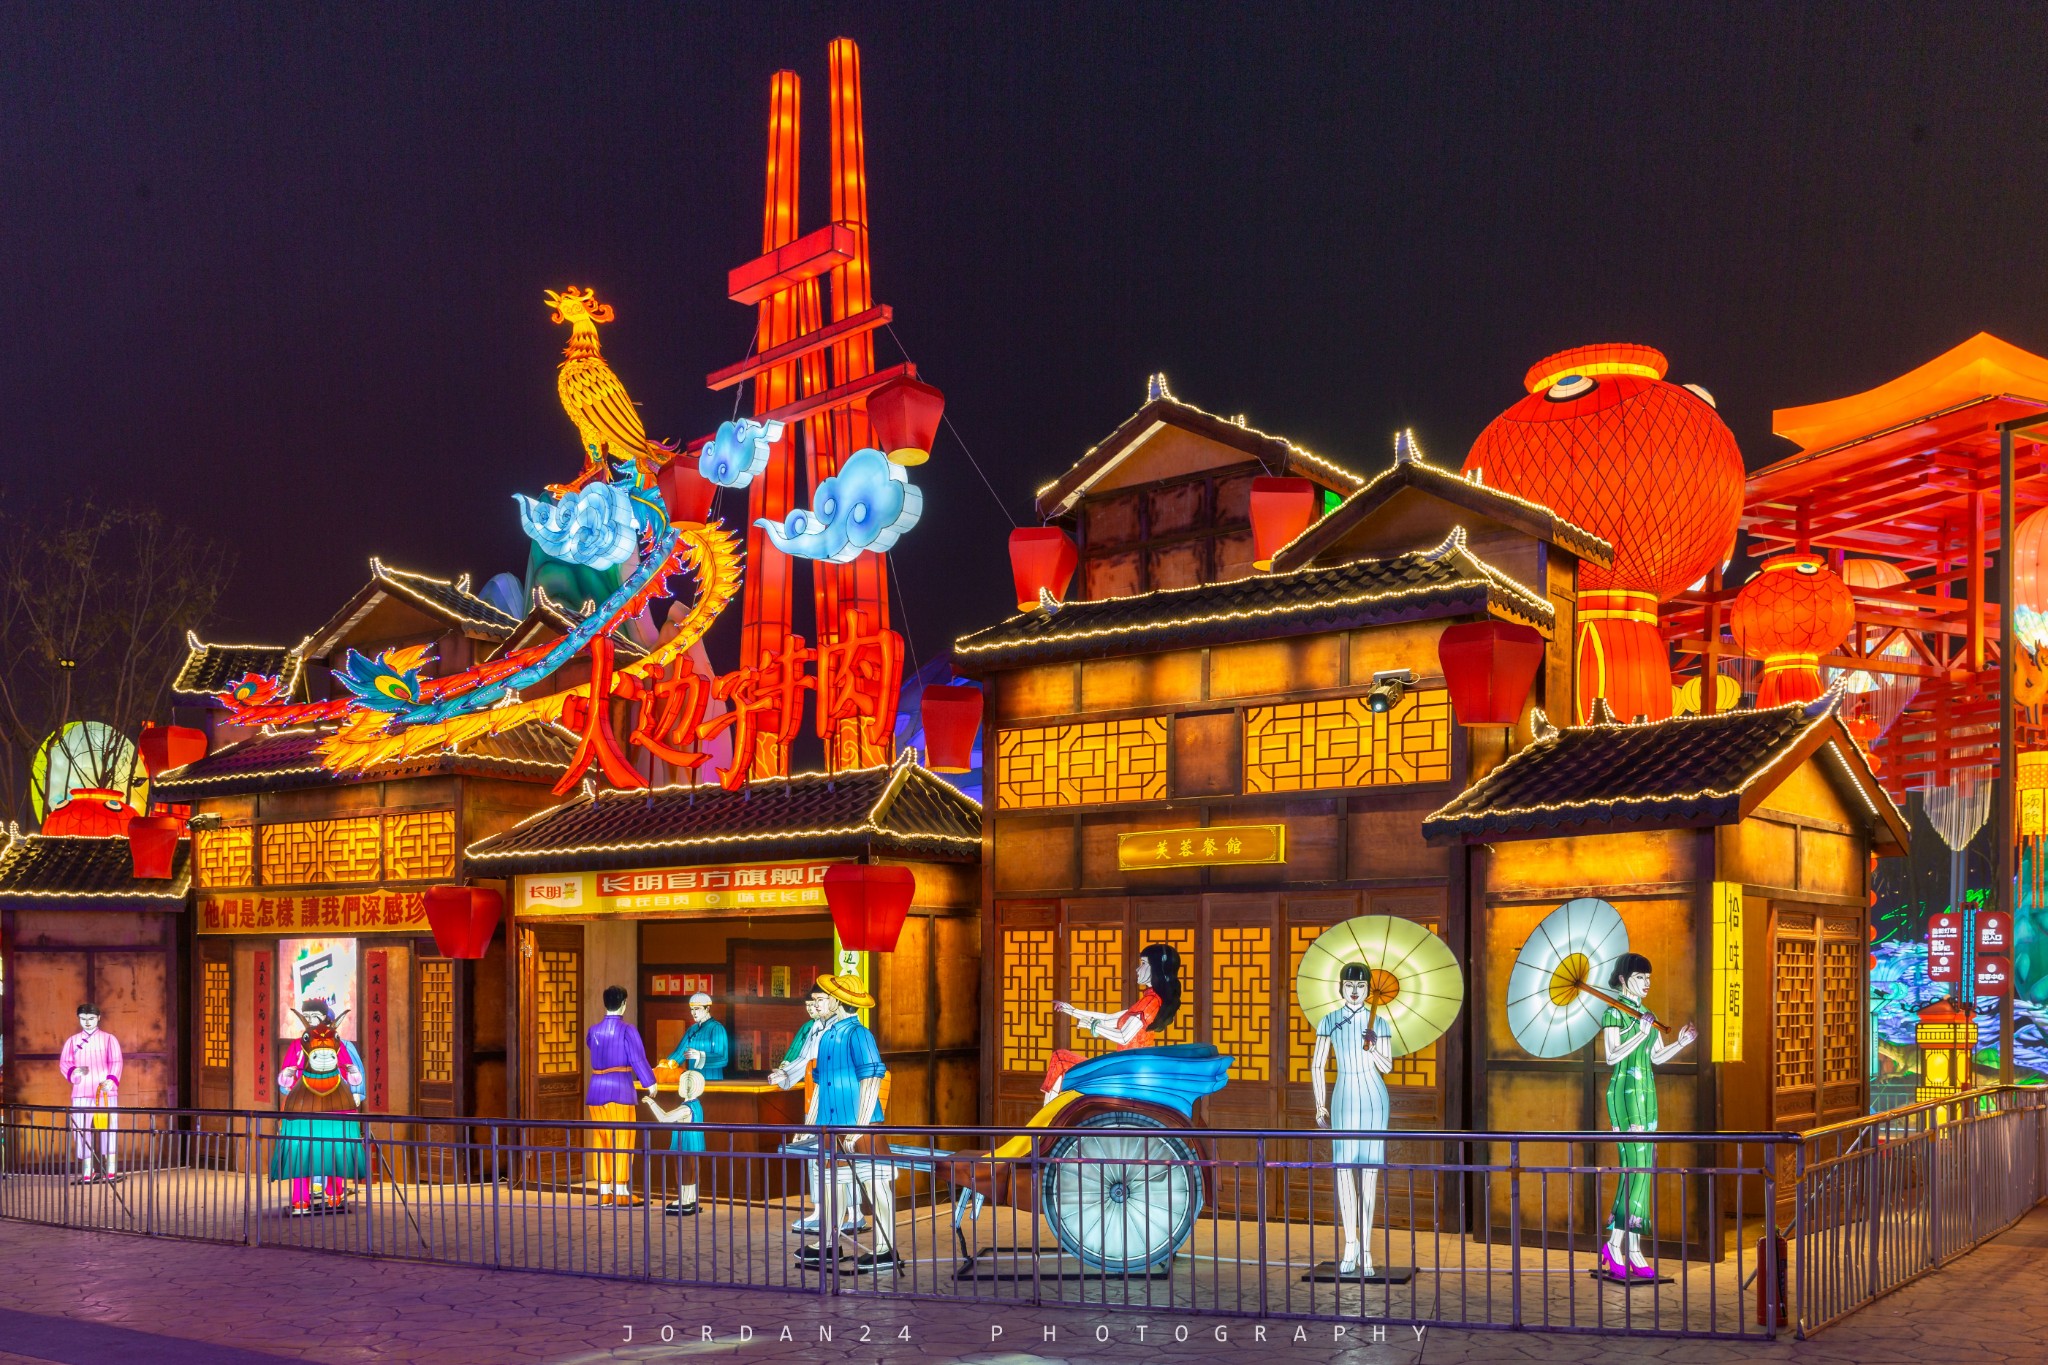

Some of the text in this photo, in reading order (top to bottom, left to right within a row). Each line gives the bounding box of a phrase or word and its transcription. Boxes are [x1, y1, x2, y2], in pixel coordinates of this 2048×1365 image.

[552, 608, 905, 796] 火边子牛肉
[1154, 836, 1243, 860] 芙蓉餐館
[602, 865, 830, 893] 长明官方旗舰店
[529, 885, 562, 900] 长明
[616, 895, 690, 908] 食在自贡
[737, 890, 819, 904] 味在长明
[203, 891, 428, 928] 他們是怎樣 讓我們深感珍
